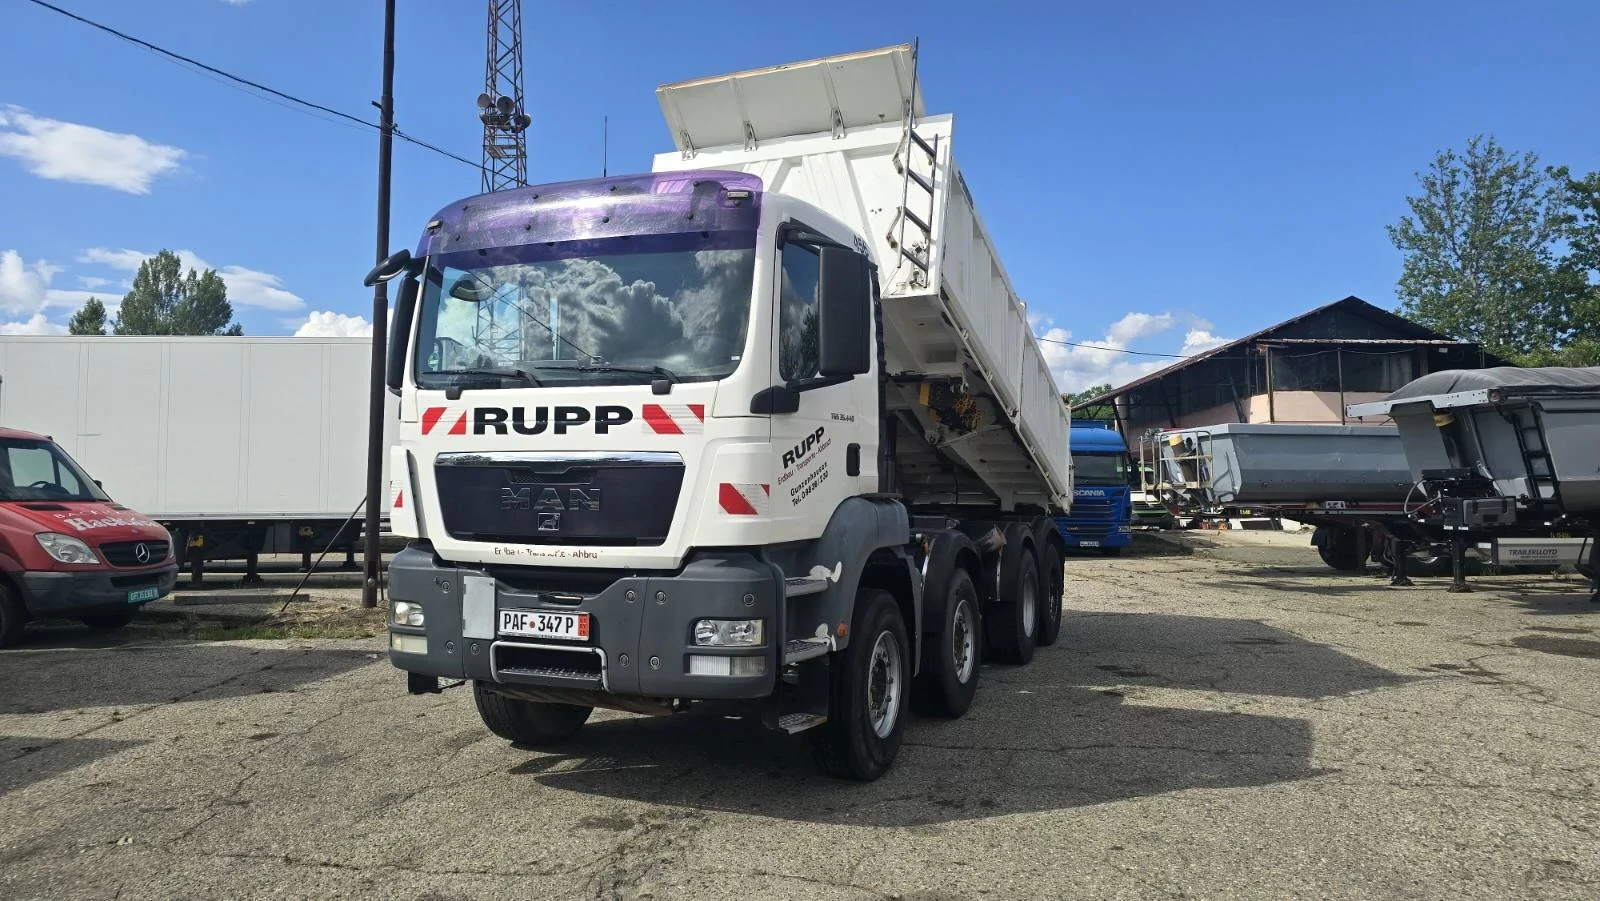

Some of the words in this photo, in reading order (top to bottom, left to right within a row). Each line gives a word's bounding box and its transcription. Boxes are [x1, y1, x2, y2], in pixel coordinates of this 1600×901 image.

[473, 405, 633, 435] RUPP
[782, 426, 825, 469] RUPP
[501, 487, 600, 511] MAN
[1072, 489, 1105, 497] SCANIA
[504, 613, 528, 631] PAF
[537, 615, 562, 633] 347
[565, 617, 574, 634] P
